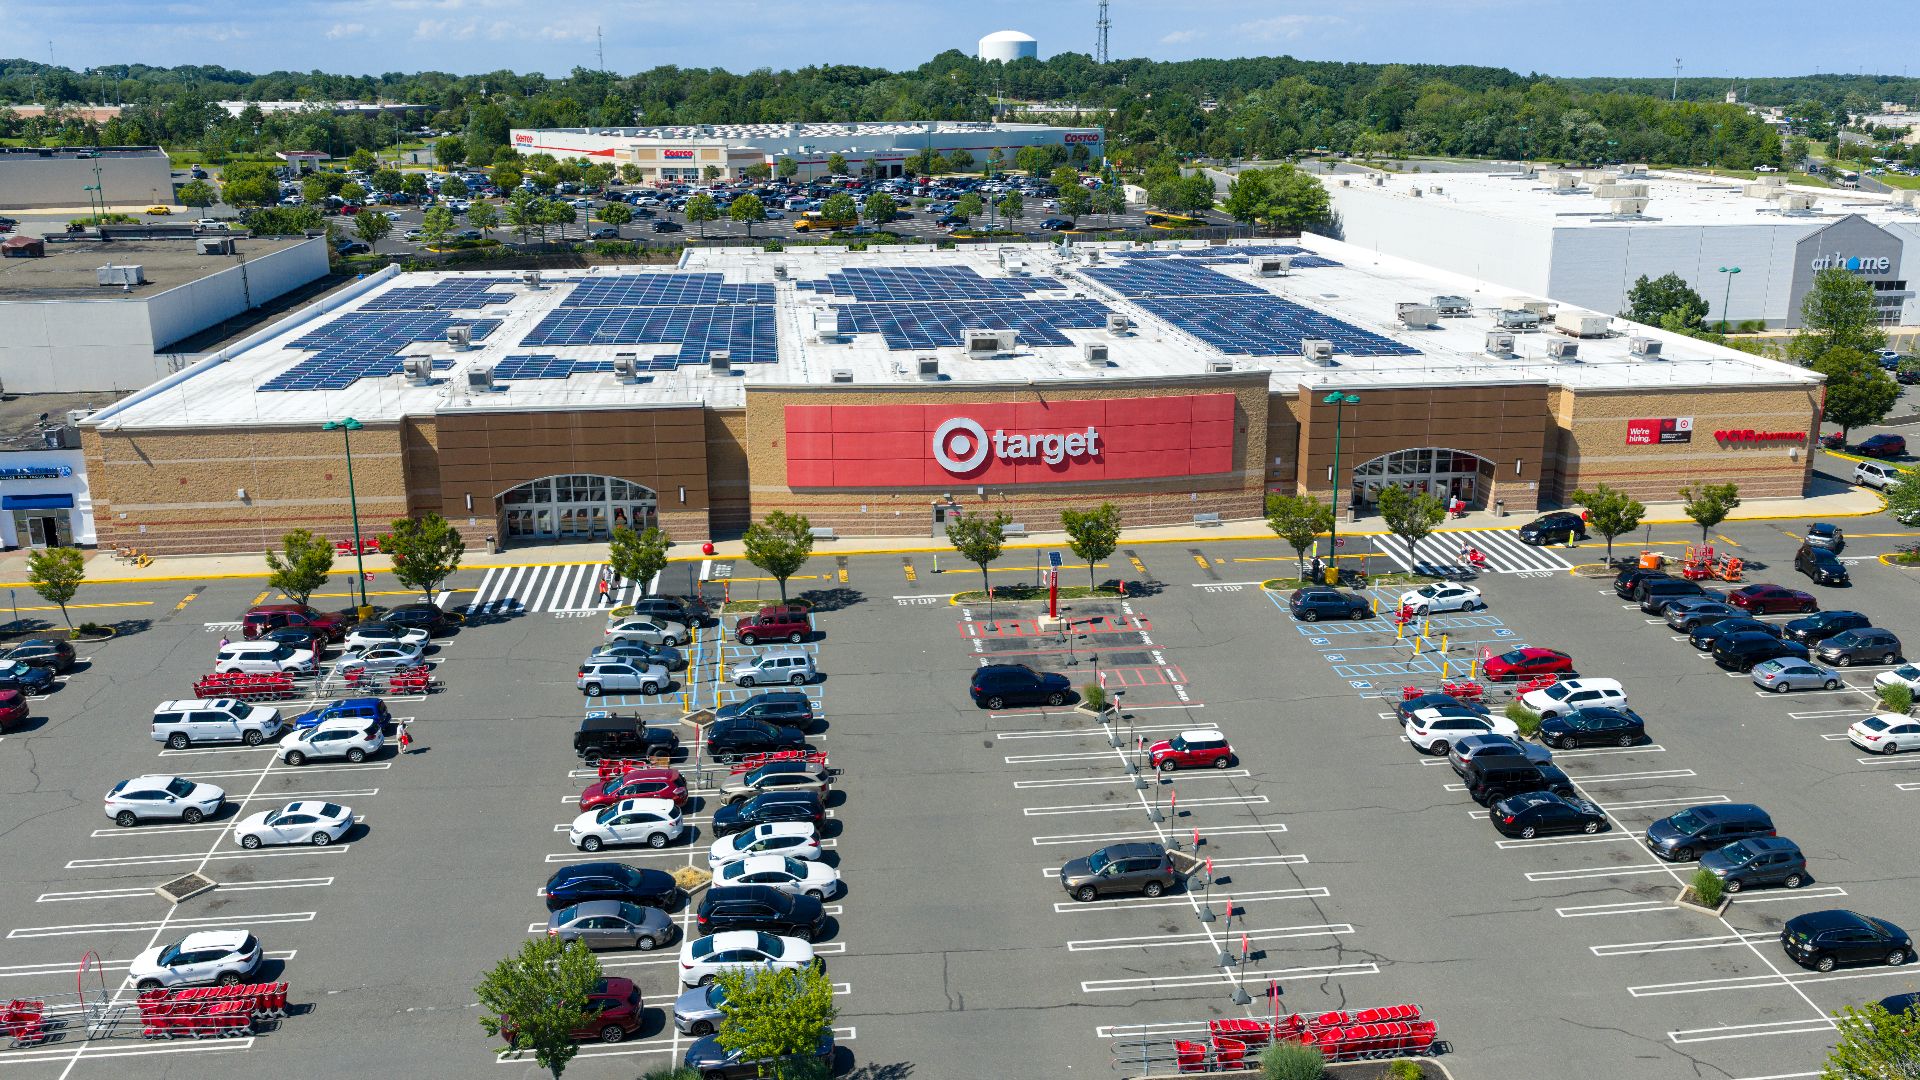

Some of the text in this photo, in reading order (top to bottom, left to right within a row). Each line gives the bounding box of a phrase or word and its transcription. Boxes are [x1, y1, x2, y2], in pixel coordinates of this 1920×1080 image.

[664, 149, 693, 157] COSTCO
[1811, 254, 1832, 271] at
[1629, 427, 1650, 435] We're
[1628, 435, 1651, 443] hiring.
[1727, 429, 1756, 443] CVS
[993, 426, 1099, 465] target
[1516, 571, 1554, 579] STOP
[897, 598, 937, 606] STOP
[554, 610, 598, 619] STOP
